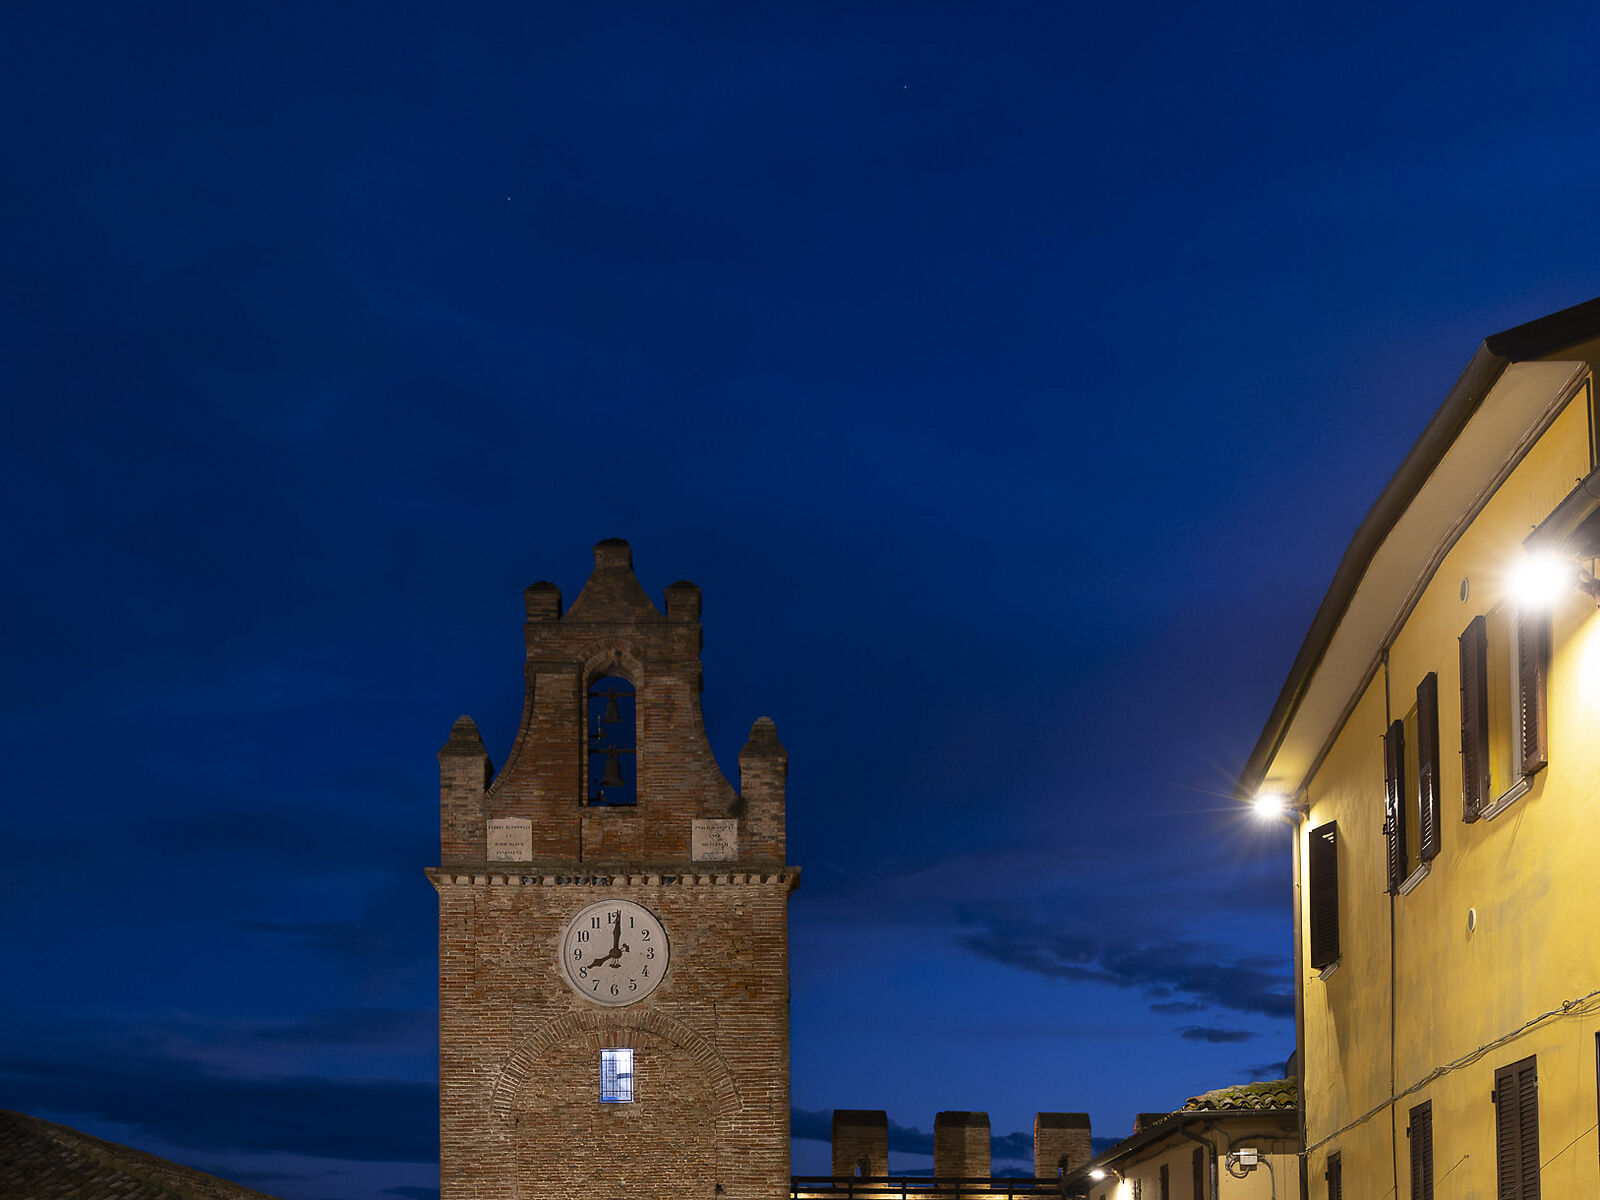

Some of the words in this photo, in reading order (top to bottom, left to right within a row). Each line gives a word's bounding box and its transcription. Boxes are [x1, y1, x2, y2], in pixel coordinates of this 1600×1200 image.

[591, 917, 601, 929] 11
[629, 916, 635, 929] 1
[577, 930, 590, 942] 10
[641, 929, 651, 942] 2
[574, 948, 582, 960] 9
[646, 947, 655, 960] 3
[579, 966, 588, 979] 8
[641, 965, 650, 978] 4
[592, 979, 601, 992] 7
[610, 983, 619, 996] 6
[629, 979, 637, 991] 5
